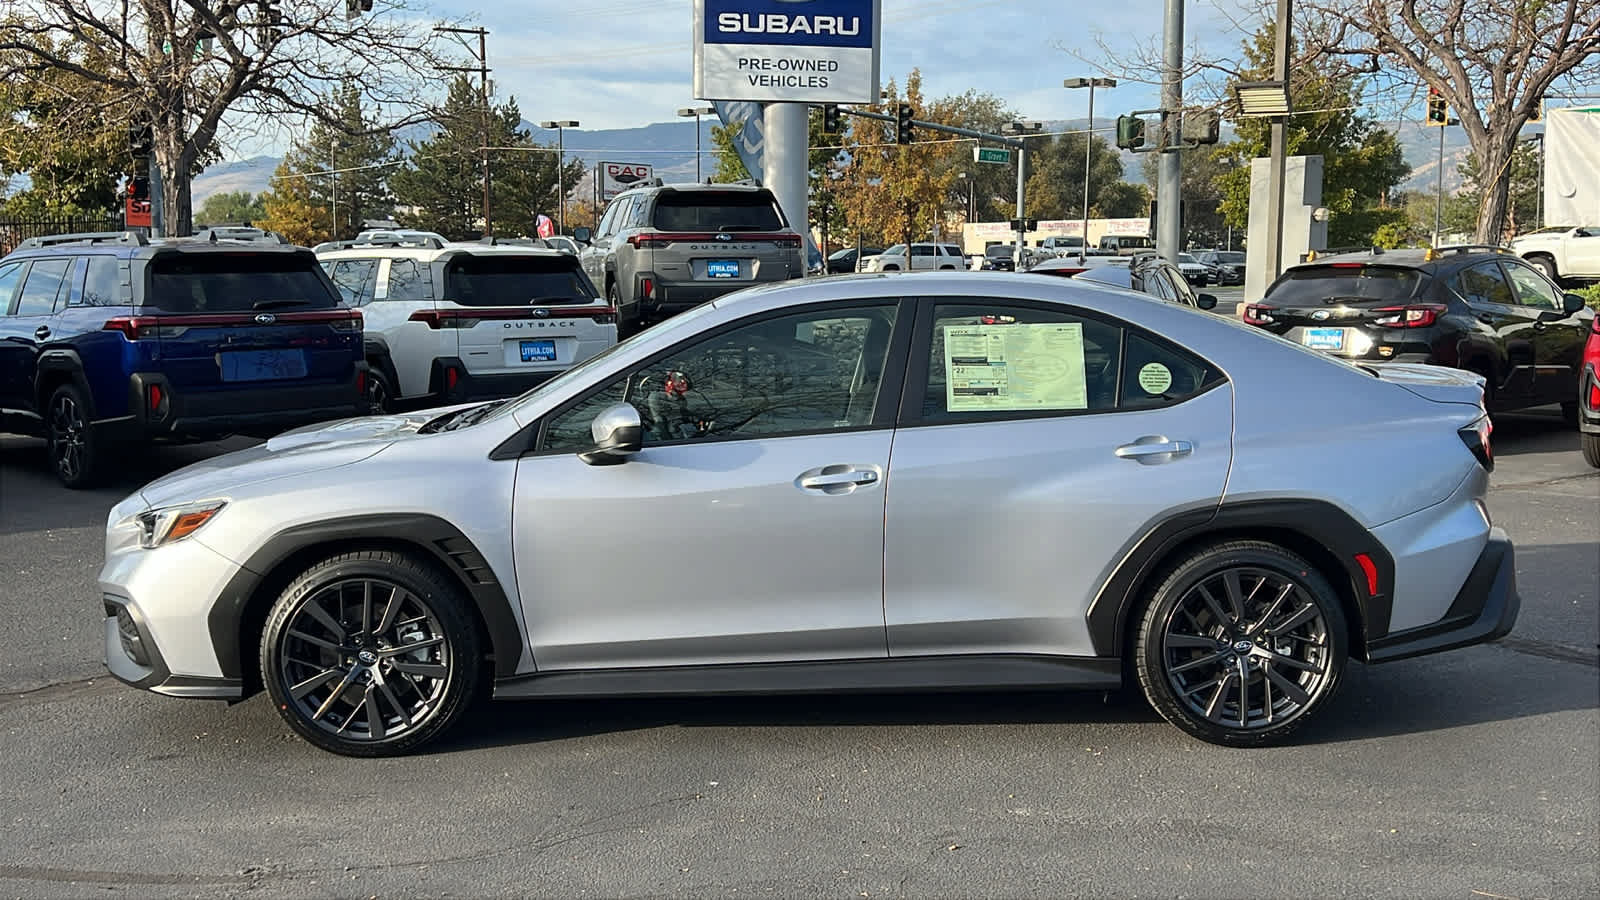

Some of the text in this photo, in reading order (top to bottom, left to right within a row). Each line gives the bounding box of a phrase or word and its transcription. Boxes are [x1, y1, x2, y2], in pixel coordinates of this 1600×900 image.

[718, 13, 859, 36] SUBARU
[738, 58, 838, 72] PRE-OWNED
[748, 75, 828, 88] VEHICLES
[608, 165, 647, 177] CAC
[503, 321, 575, 329] OUTBACK
[521, 345, 555, 356] LITHIA.COM
